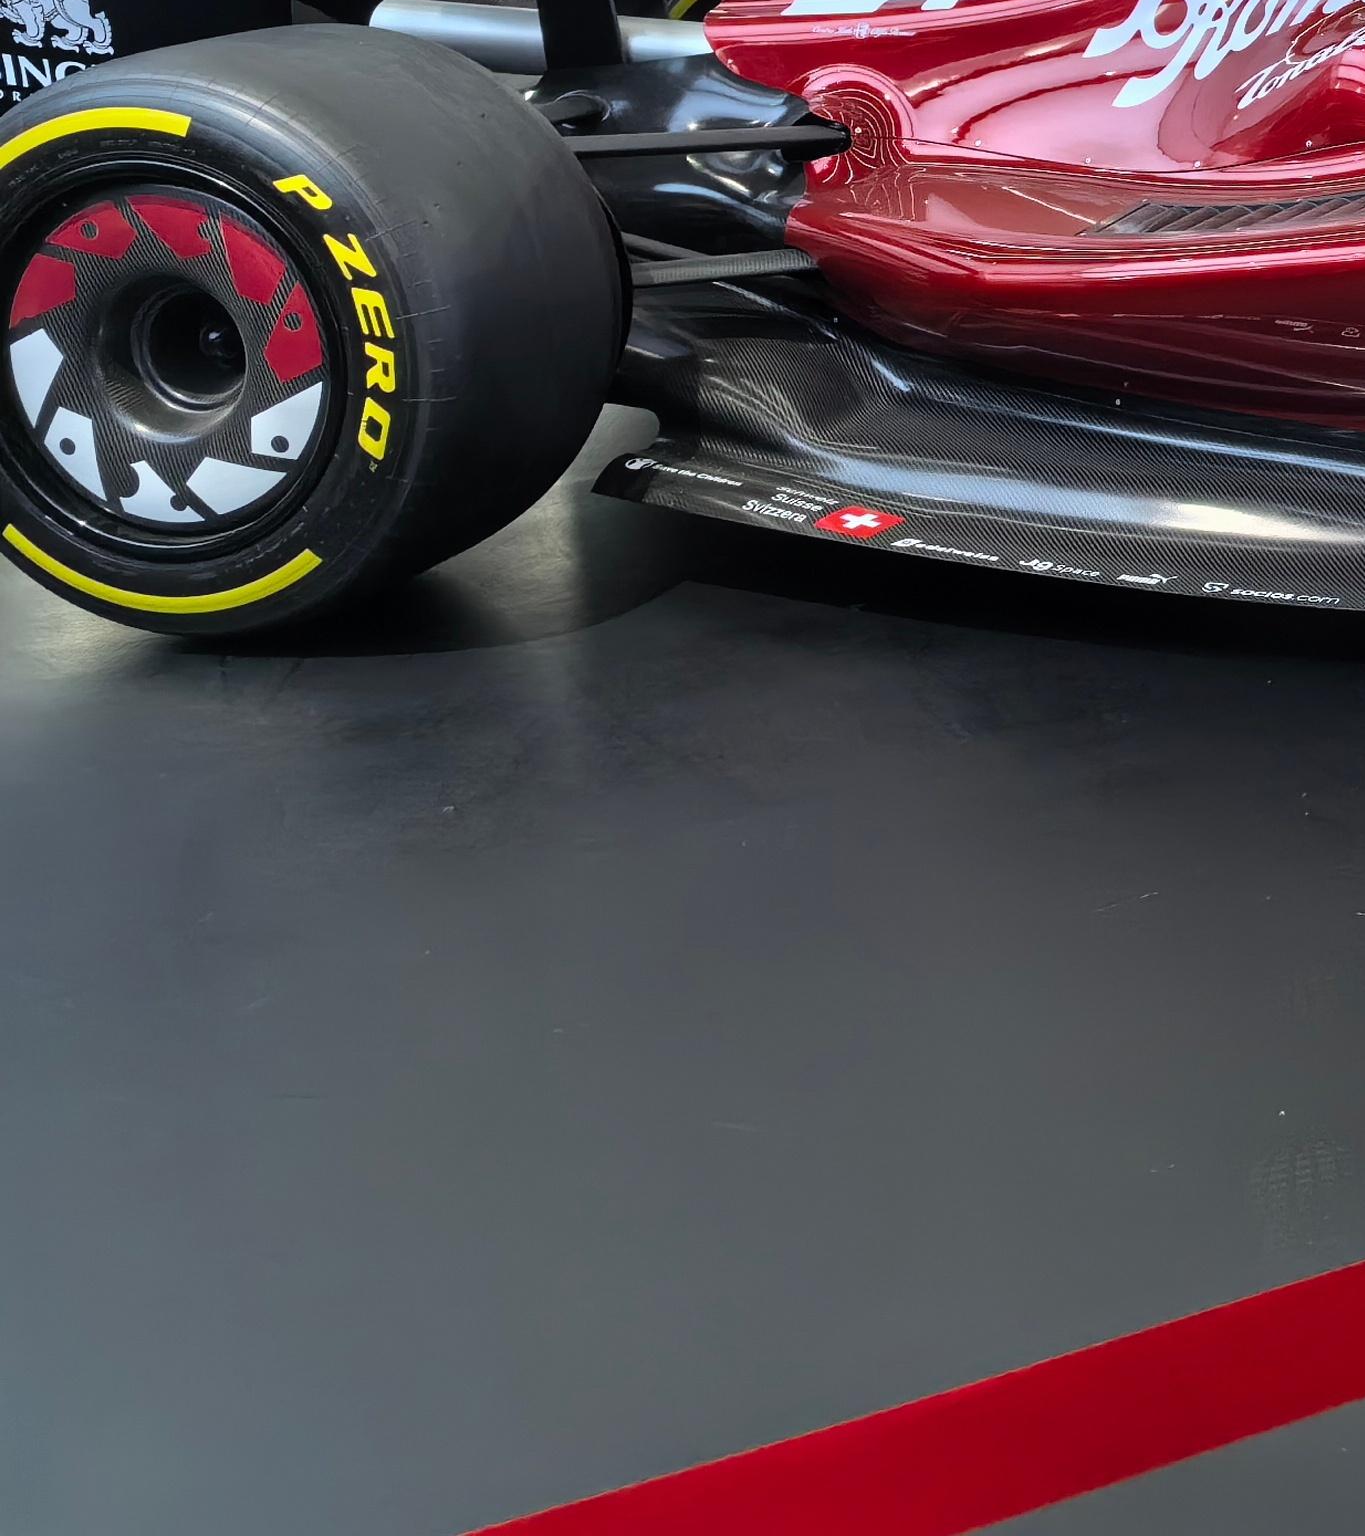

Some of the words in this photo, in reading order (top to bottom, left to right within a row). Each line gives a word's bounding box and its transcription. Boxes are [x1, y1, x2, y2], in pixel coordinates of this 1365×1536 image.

[273, 174, 333, 210] P
[323, 233, 395, 462] ZERO
[697, 472, 744, 488] Children
[742, 499, 808, 524] Svizzera
[770, 493, 825, 513] Suisse
[1229, 588, 1341, 606] socios.com
